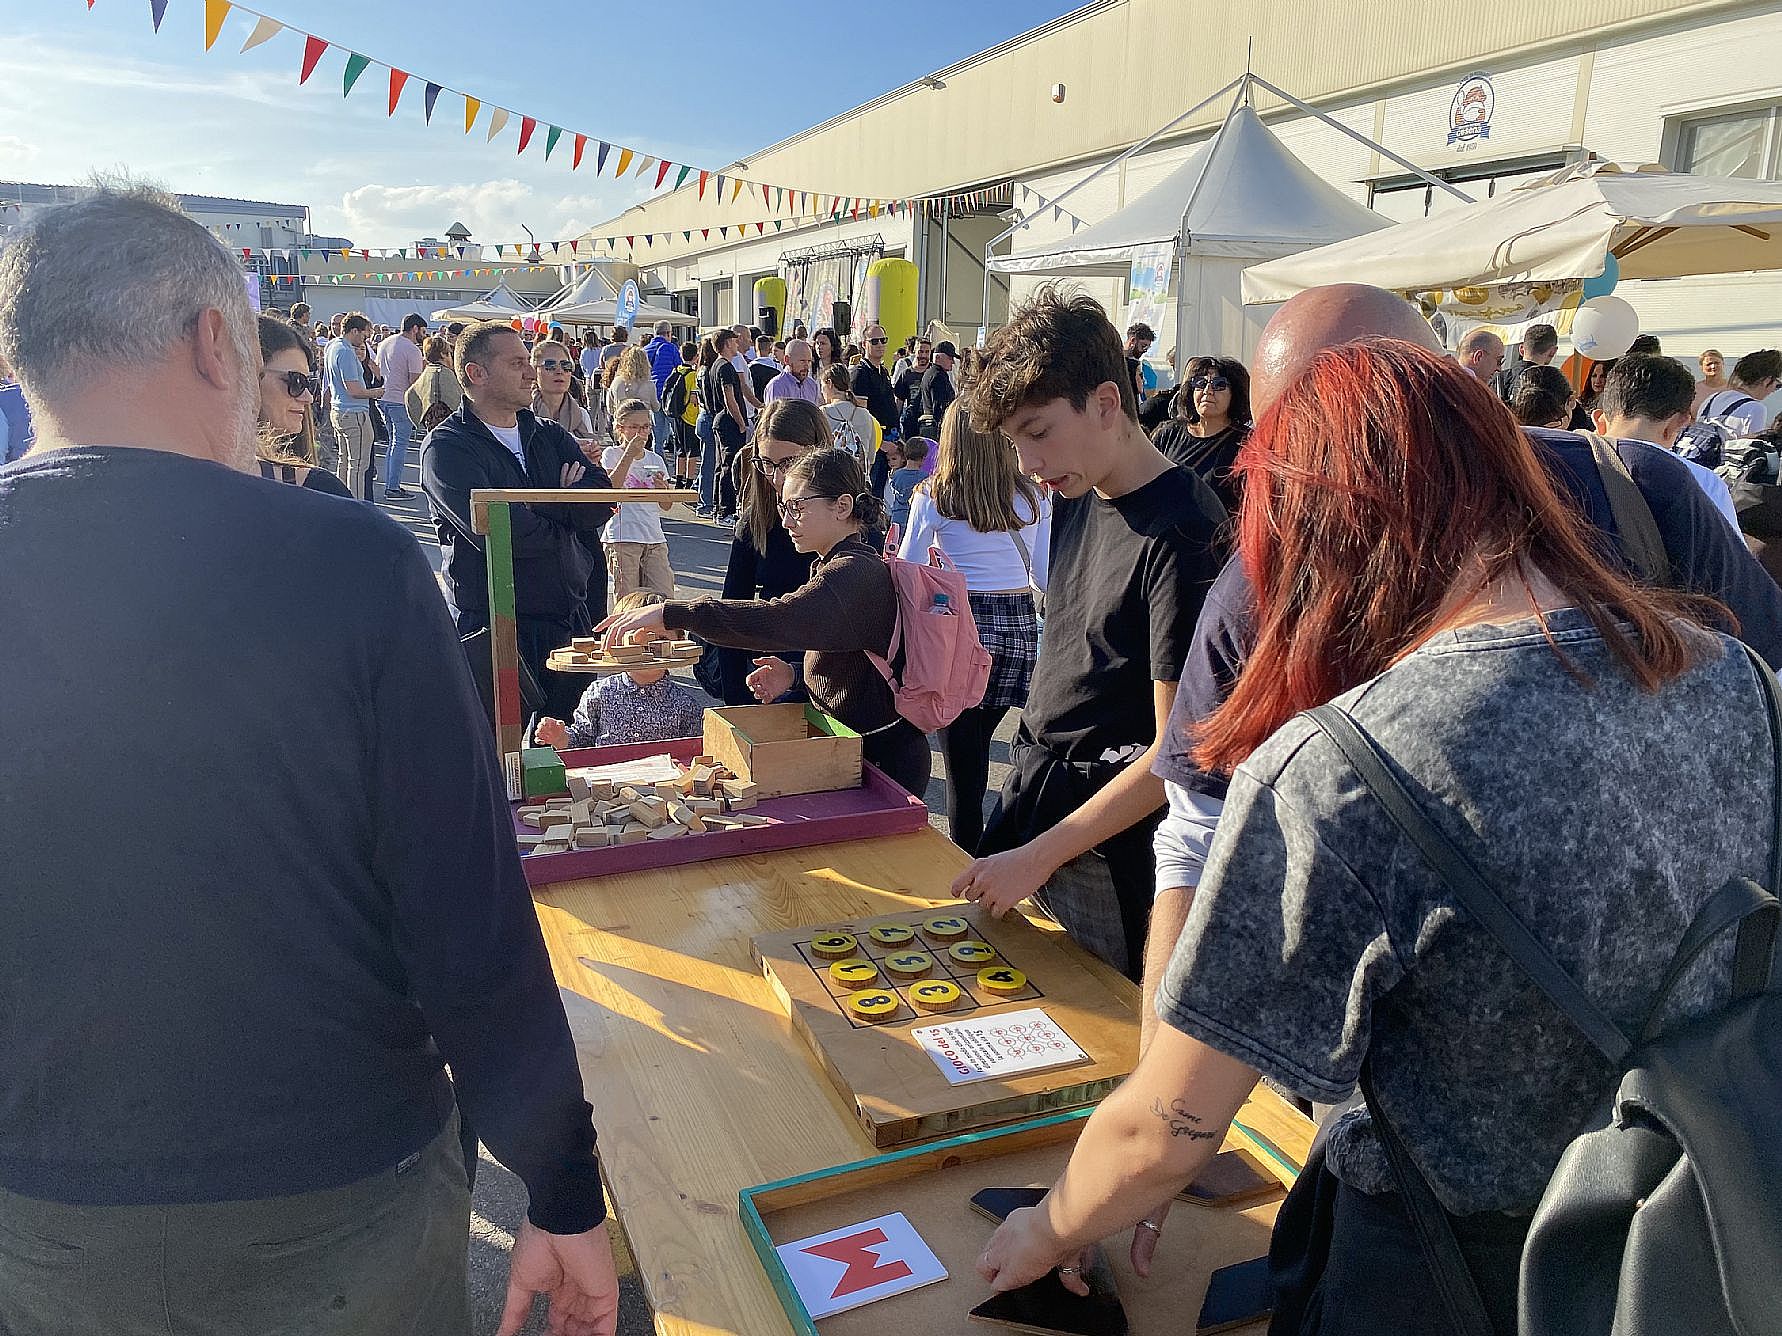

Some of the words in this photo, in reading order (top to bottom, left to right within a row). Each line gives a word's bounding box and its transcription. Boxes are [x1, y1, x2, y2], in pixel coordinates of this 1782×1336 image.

[928, 1028, 942, 1036] 15
[932, 1037, 950, 1049] del
[943, 1049, 971, 1075] GIOCO
